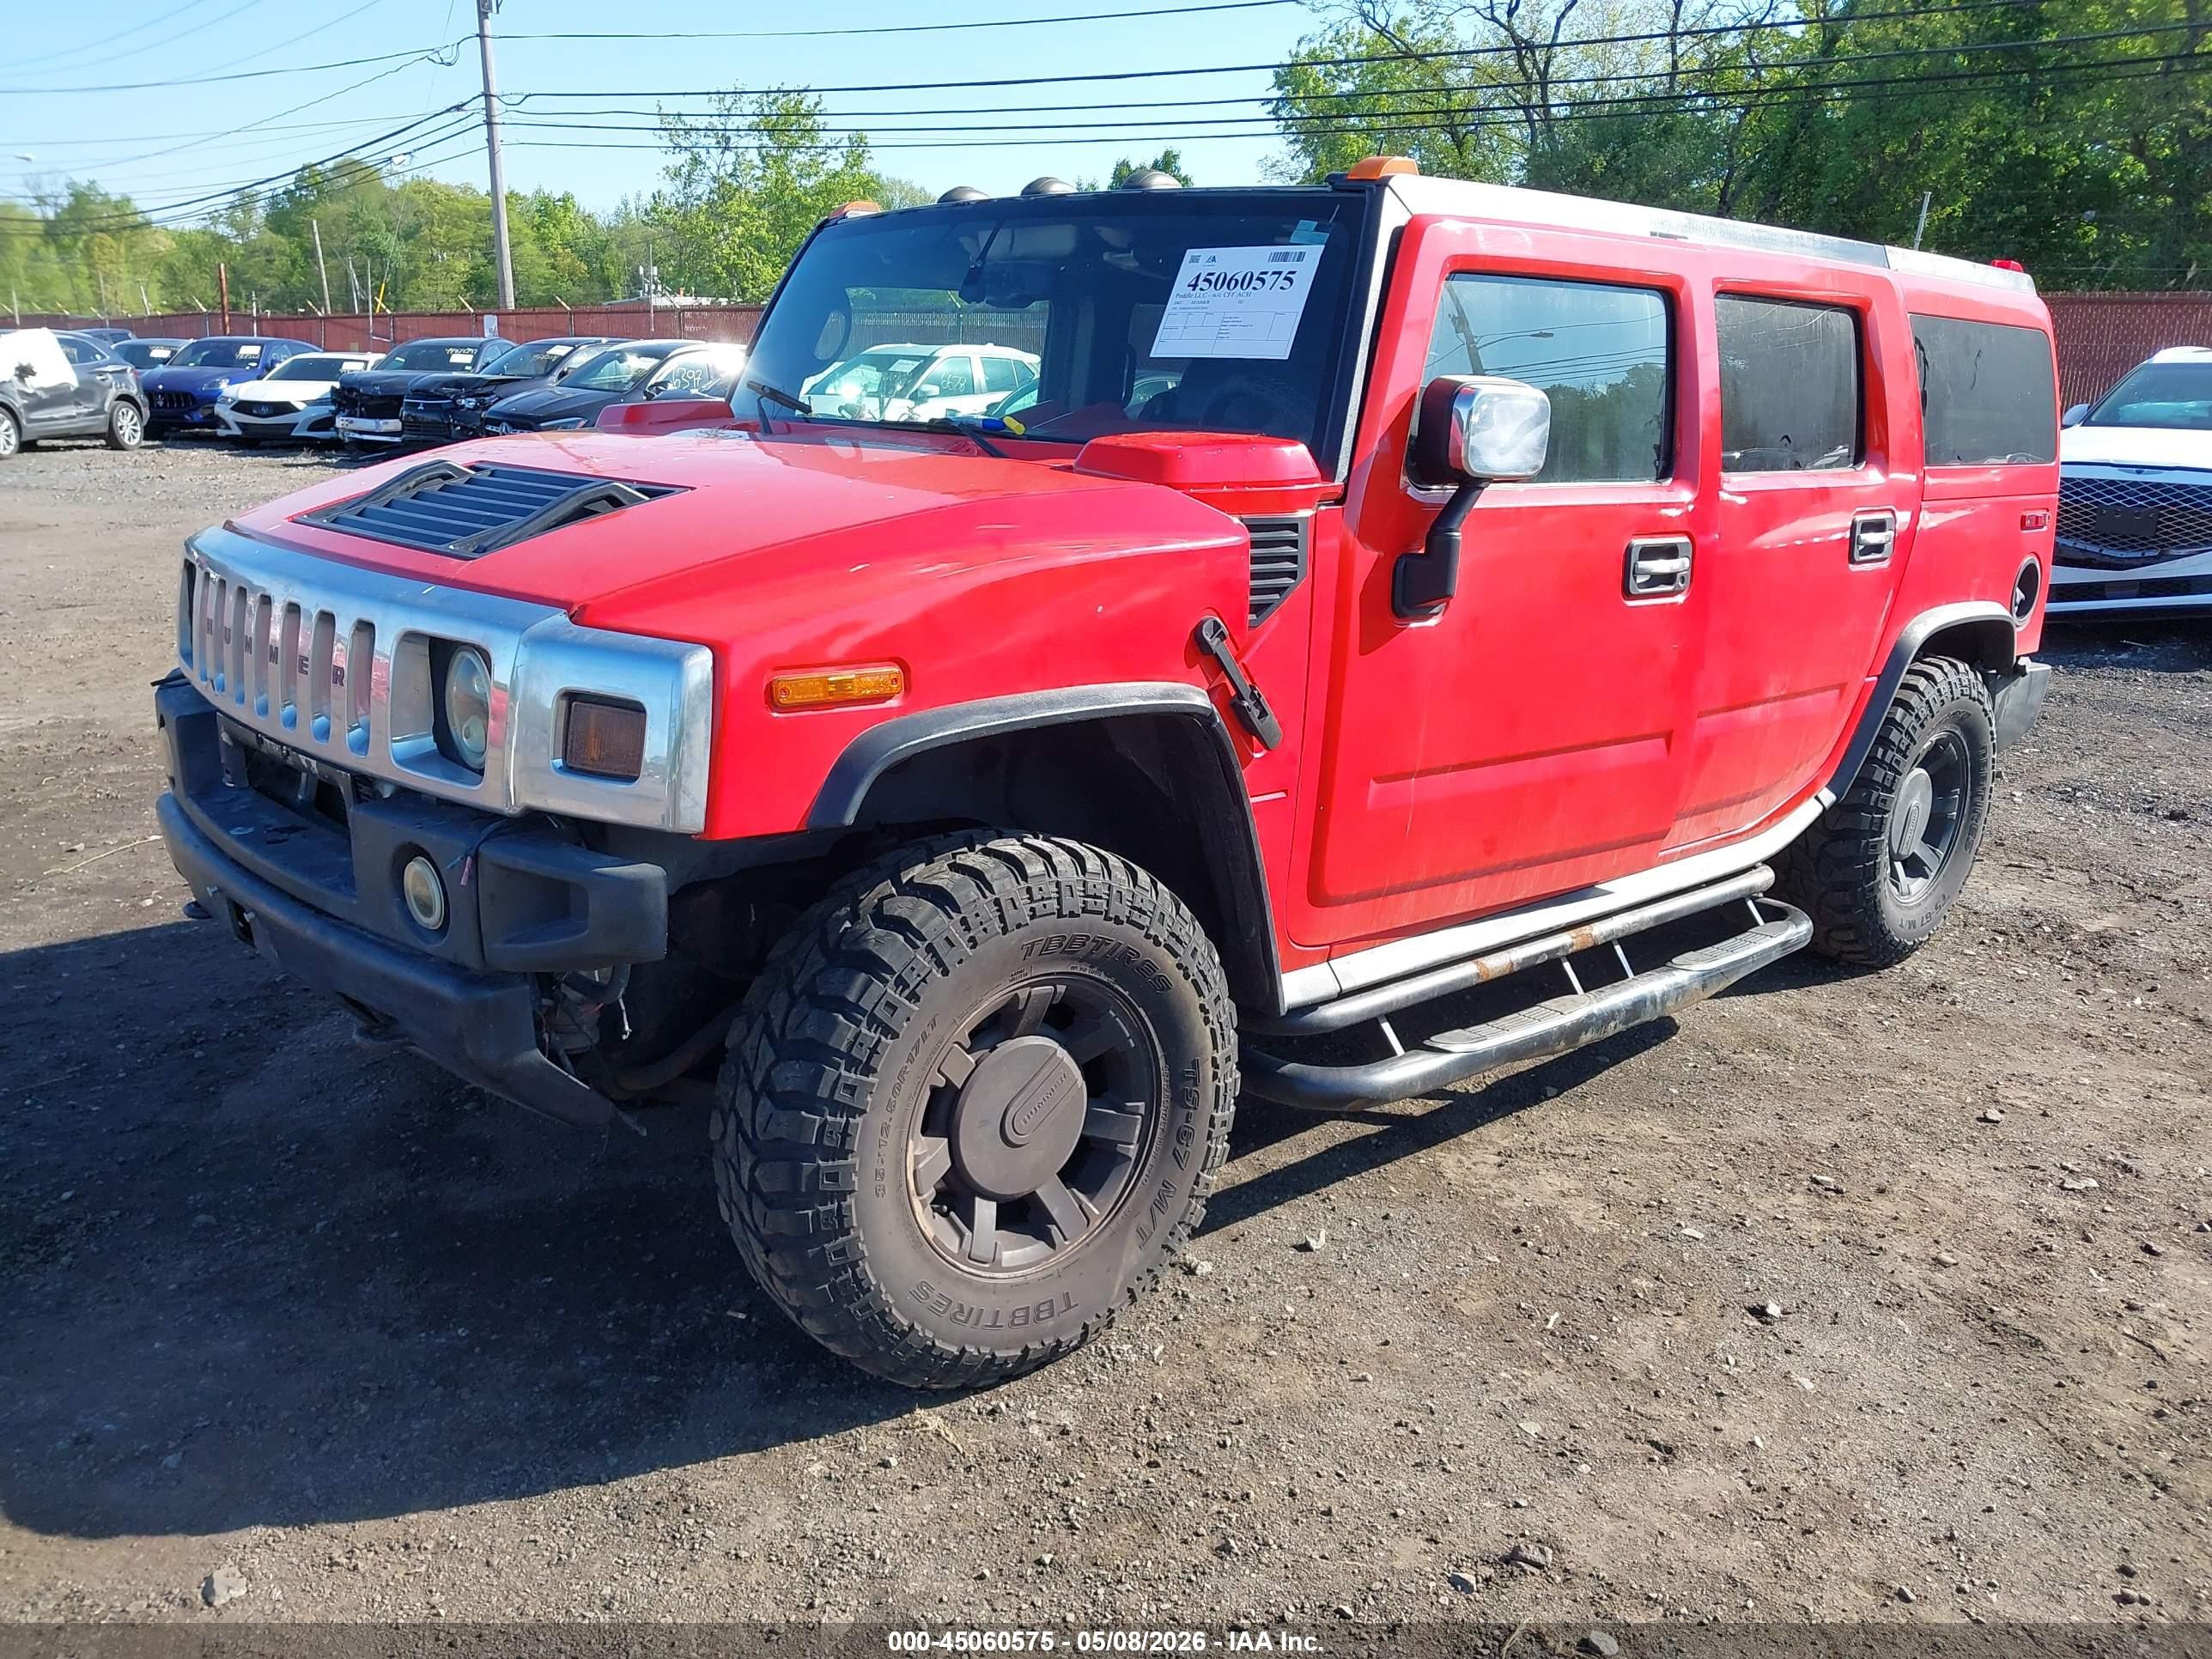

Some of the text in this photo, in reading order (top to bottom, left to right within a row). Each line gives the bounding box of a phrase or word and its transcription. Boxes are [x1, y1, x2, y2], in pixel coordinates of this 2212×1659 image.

[1187, 270, 1297, 292] 45060575
[206, 618, 345, 687] HUMMER
[1921, 893, 1950, 927] TS-67
[1021, 933, 1175, 994] TBBTIRES
[1135, 1056, 1201, 1250] TS-67 M/T
[908, 1279, 1079, 1331] TBBTIRES
